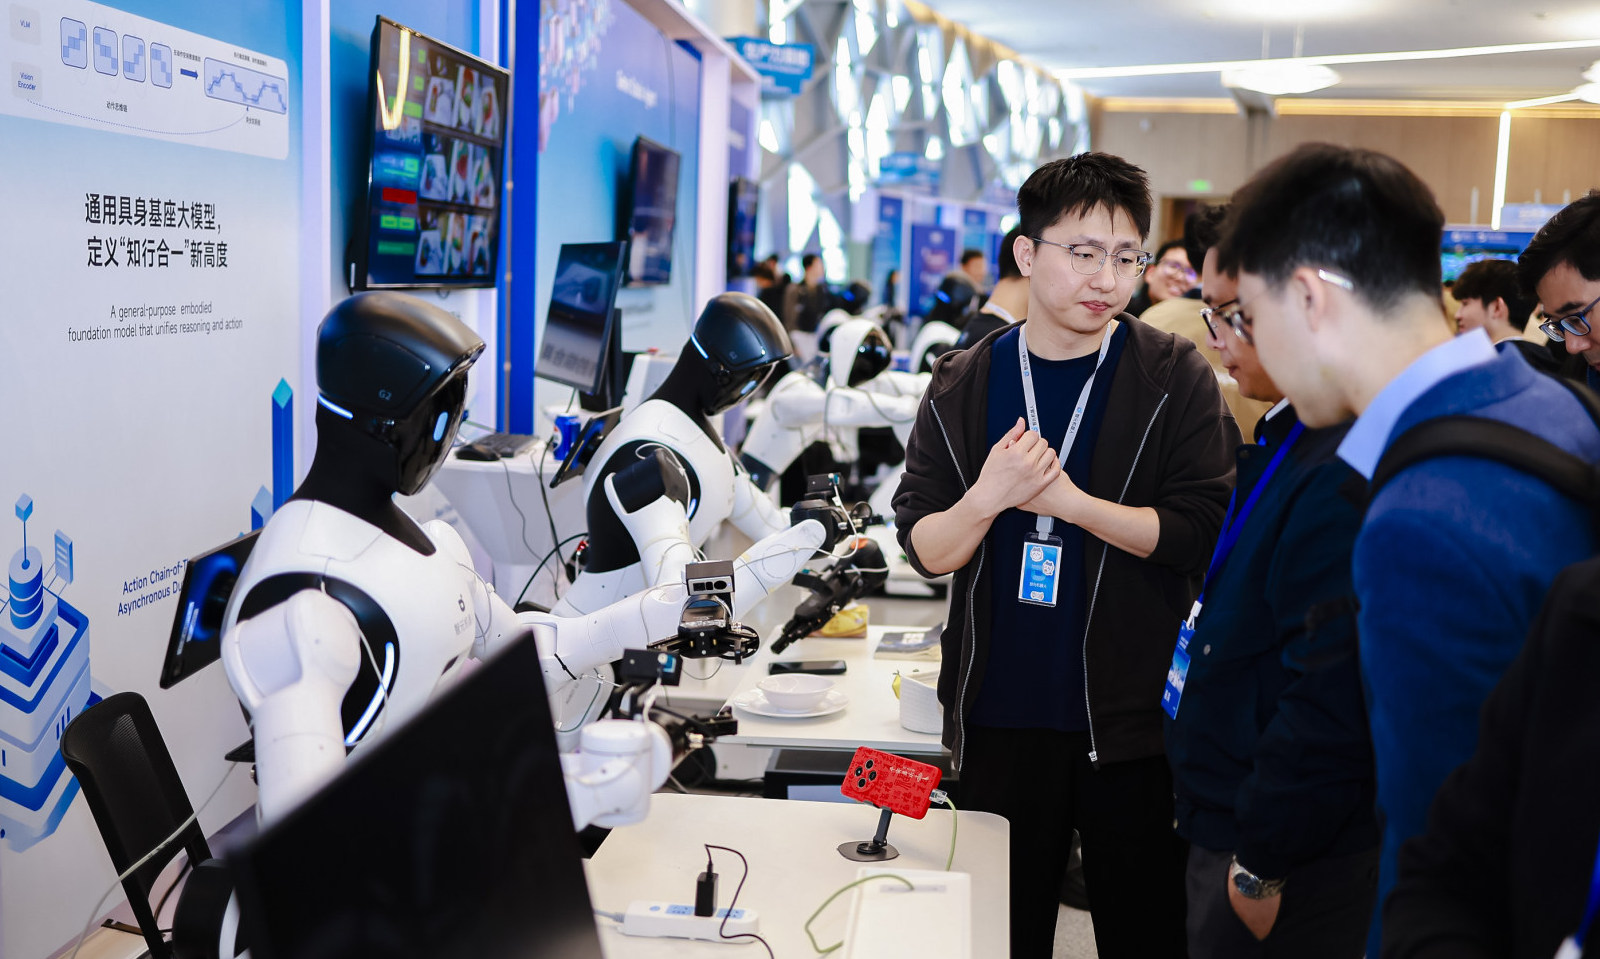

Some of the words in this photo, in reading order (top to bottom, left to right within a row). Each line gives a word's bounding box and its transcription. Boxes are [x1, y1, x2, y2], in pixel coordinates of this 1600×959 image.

[17, 80, 37, 91] Encoder
[87, 236, 228, 268] 定义“知行合一”新高度
[110, 305, 117, 318] A
[118, 303, 176, 322] general-purpose
[180, 301, 212, 315] embodied
[68, 326, 112, 342] foundation
[114, 323, 137, 338] model
[139, 323, 153, 337] that
[155, 320, 178, 335] unifies
[179, 319, 211, 335] reasoning
[212, 317, 224, 331] and
[225, 317, 243, 330] action
[123, 576, 148, 595] Action
[149, 558, 188, 584] Chain-of-T
[117, 587, 171, 616] Asynchronous
[172, 581, 184, 594] Du
